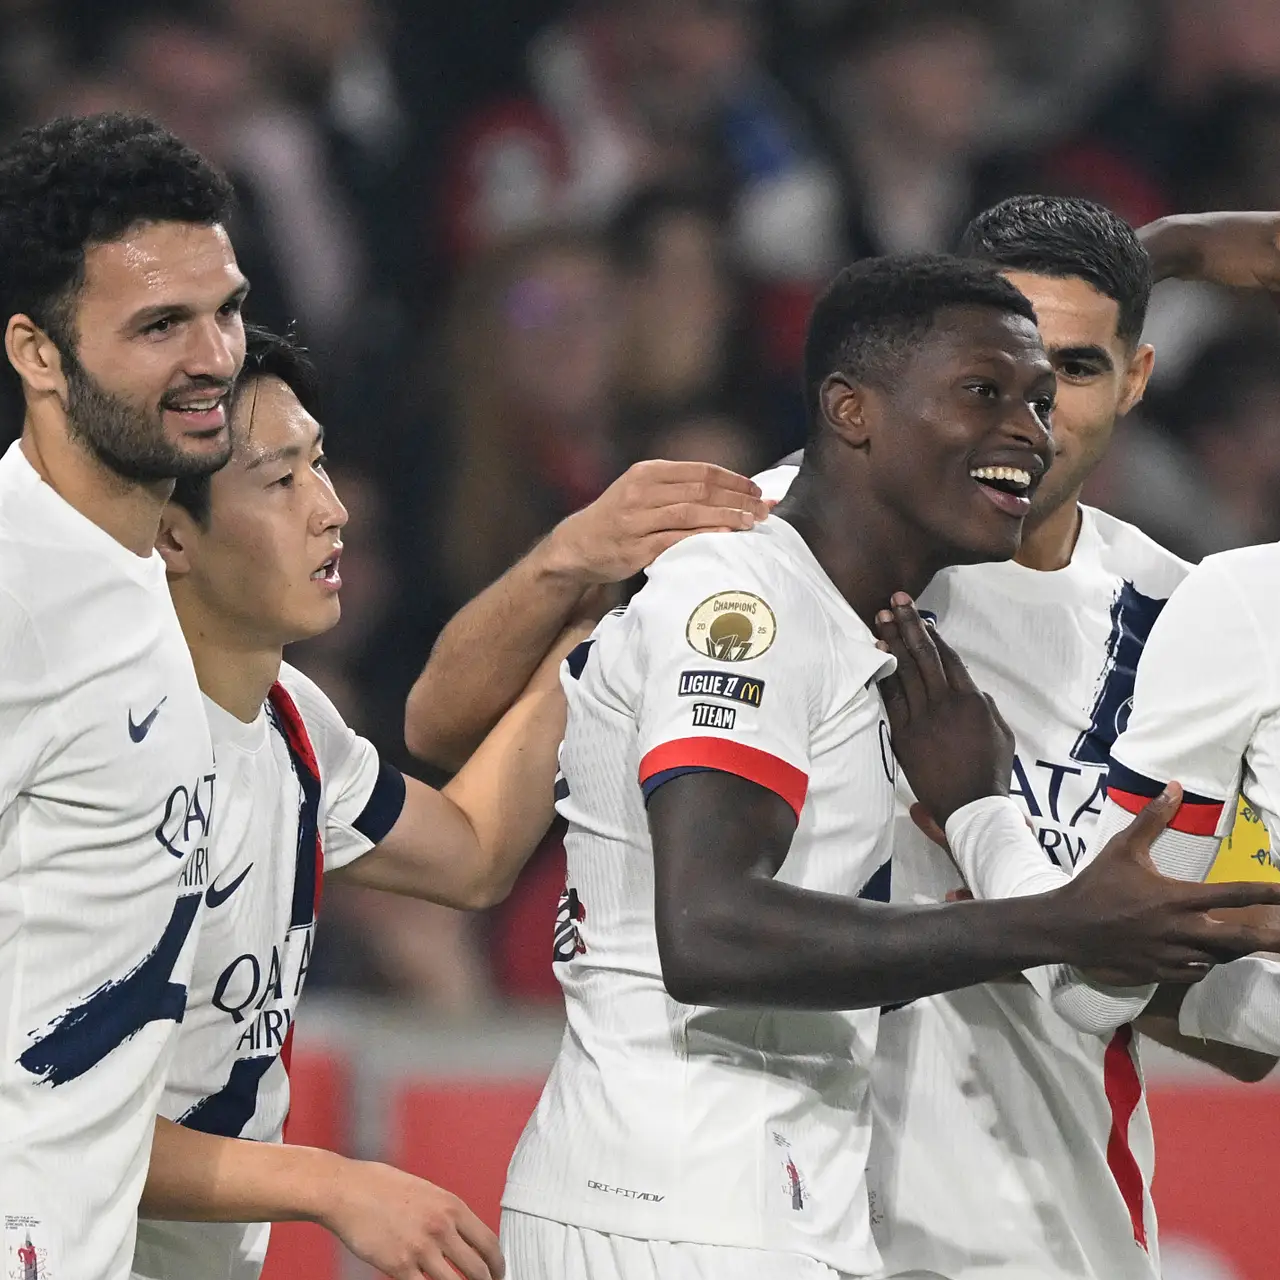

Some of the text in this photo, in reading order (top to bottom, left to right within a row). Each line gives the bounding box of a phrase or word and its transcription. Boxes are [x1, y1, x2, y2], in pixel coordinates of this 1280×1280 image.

[713, 599, 757, 615] CHAMPIONS
[696, 622, 706, 630] 20
[680, 674, 723, 695] LIGUE
[178, 846, 209, 887] AIR
